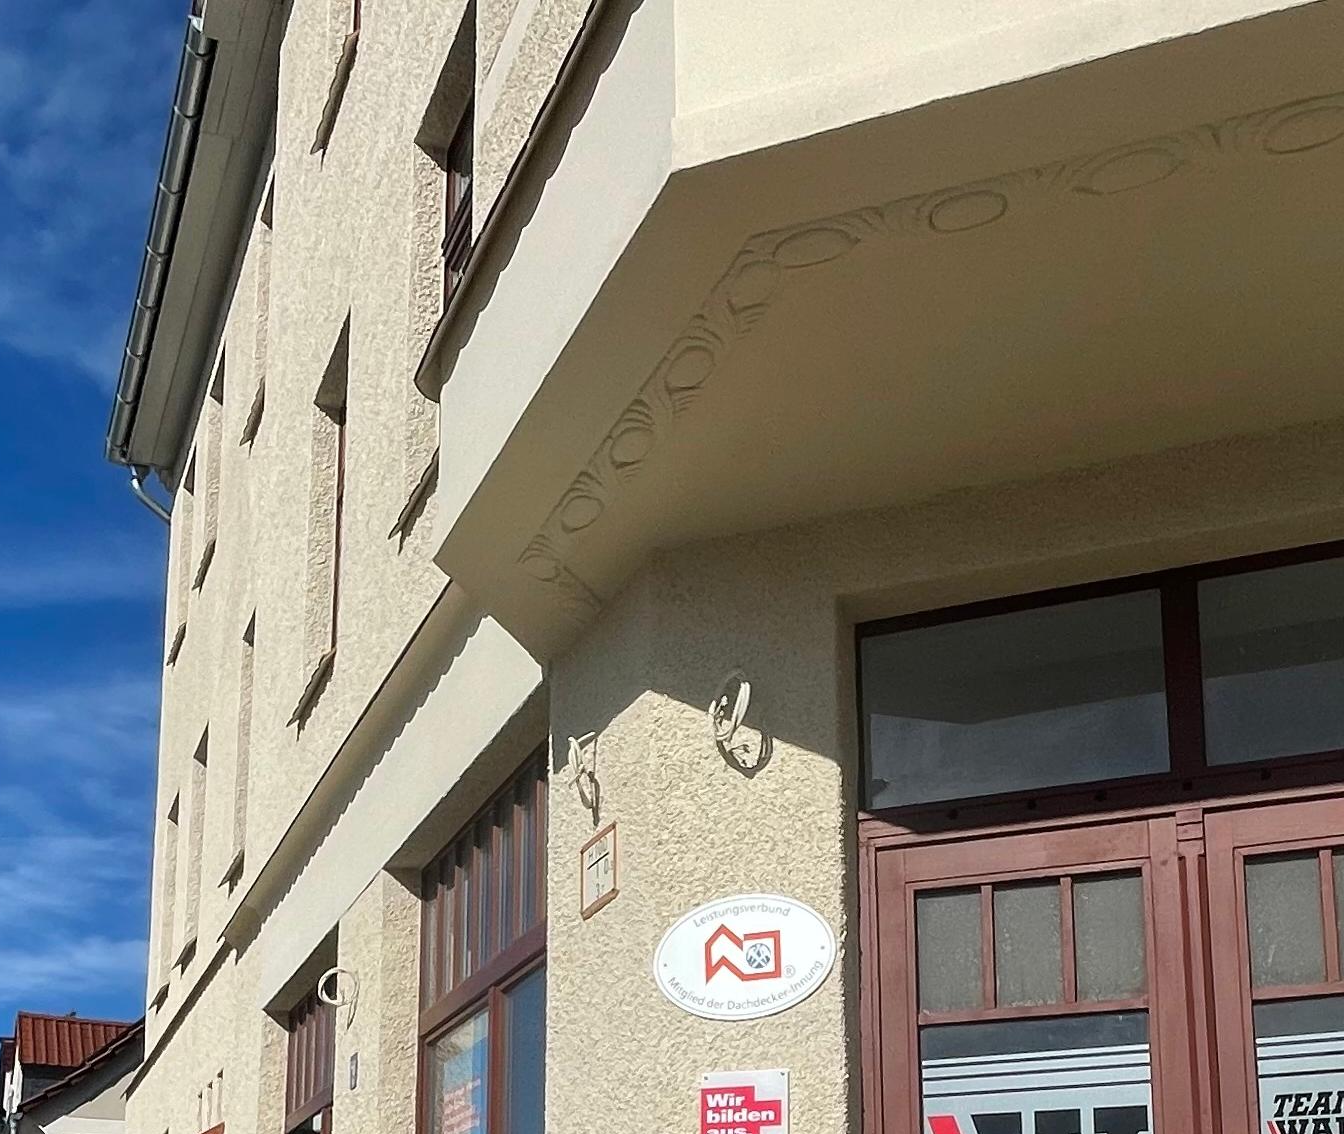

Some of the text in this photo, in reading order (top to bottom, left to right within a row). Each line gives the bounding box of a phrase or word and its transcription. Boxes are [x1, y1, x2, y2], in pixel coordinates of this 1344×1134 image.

[692, 902, 792, 928] Leistungsverbund
[667, 959, 825, 1011] Mitglied der Dachdecker-Innung
[705, 1092, 746, 1108] Wir
[705, 1107, 776, 1124] bilden
